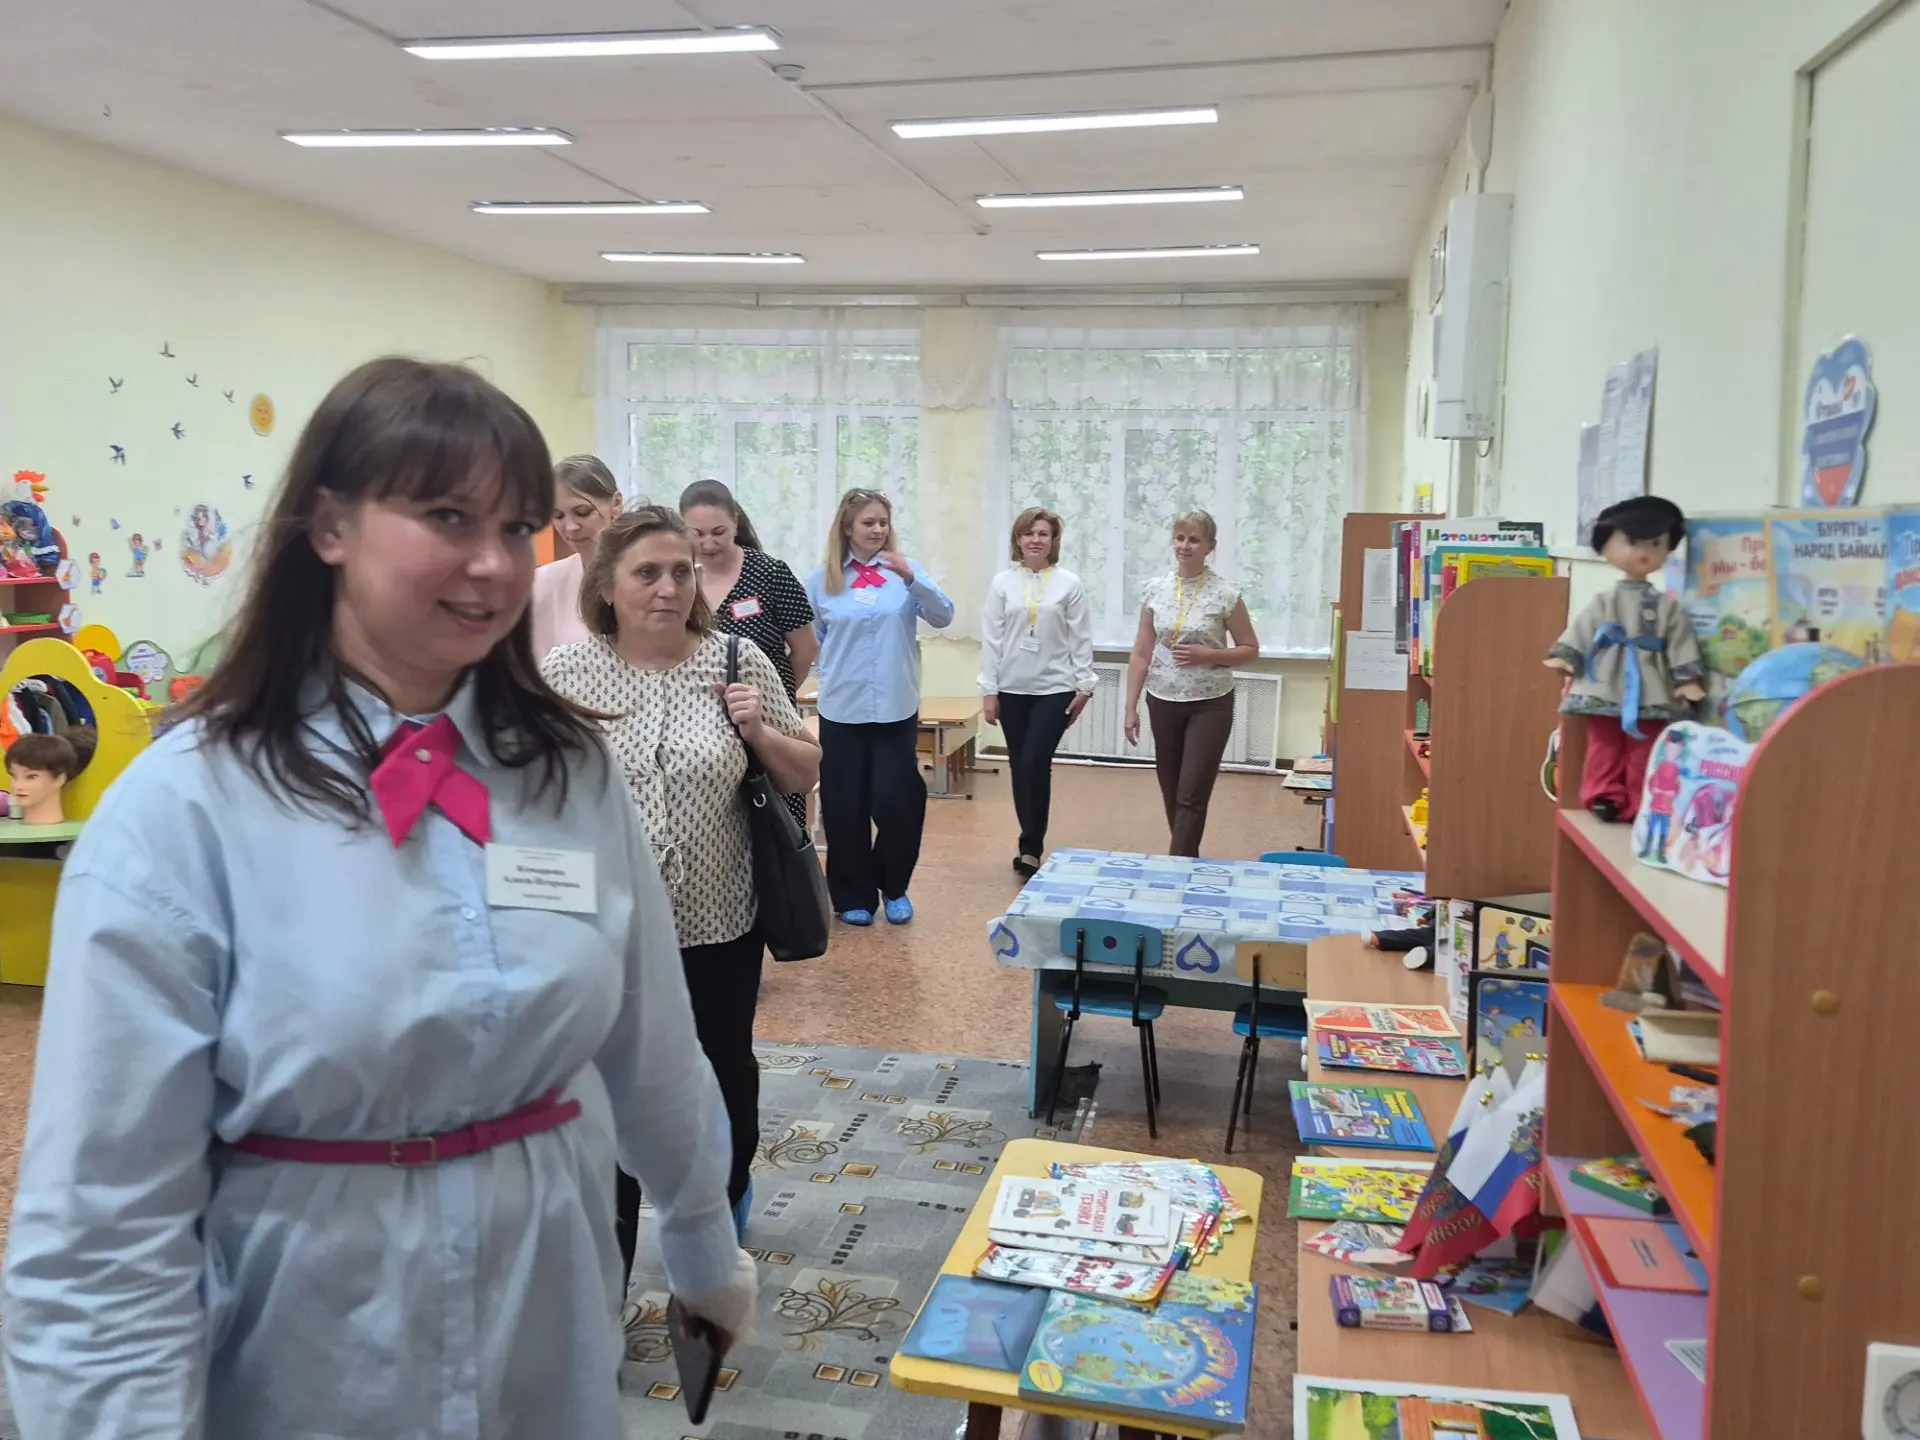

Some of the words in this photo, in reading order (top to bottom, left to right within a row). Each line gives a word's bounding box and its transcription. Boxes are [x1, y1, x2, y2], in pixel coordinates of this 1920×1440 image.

[1818, 521, 1868, 537] БУРЯТЫ
[1795, 543, 1836, 560] НАРОД
[1077, 1193, 1095, 1225] ТЕХНИКА
